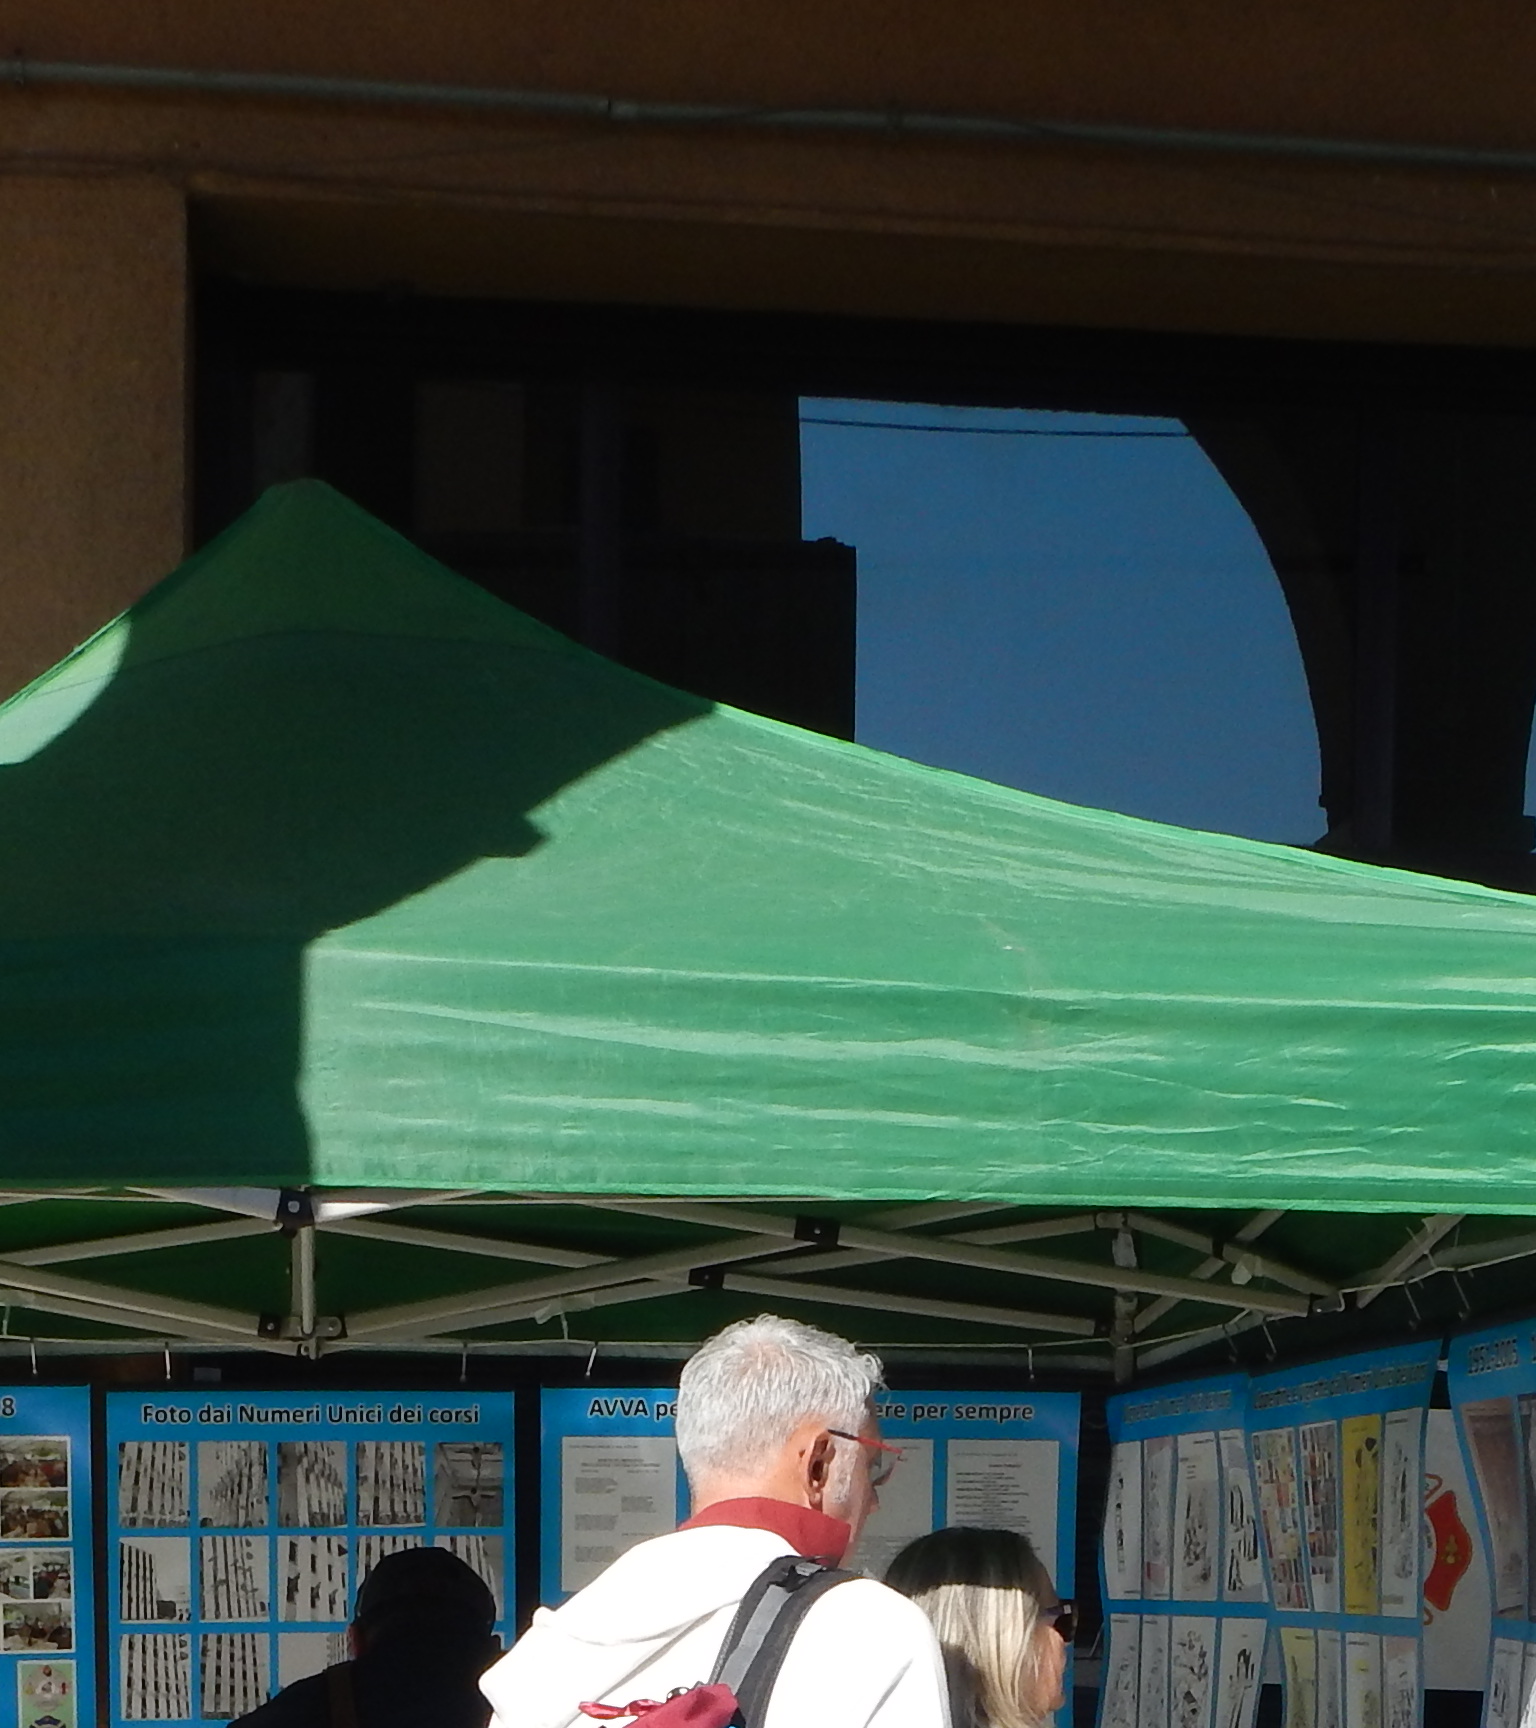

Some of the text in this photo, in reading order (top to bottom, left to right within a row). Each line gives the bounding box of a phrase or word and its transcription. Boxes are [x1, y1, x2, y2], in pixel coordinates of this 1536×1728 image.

[143, 1404, 480, 1423] Foto dai Numeri Unici dei corsi
[589, 1399, 678, 1421] AVVA pe
[876, 1404, 1033, 1423] ere per sempre
